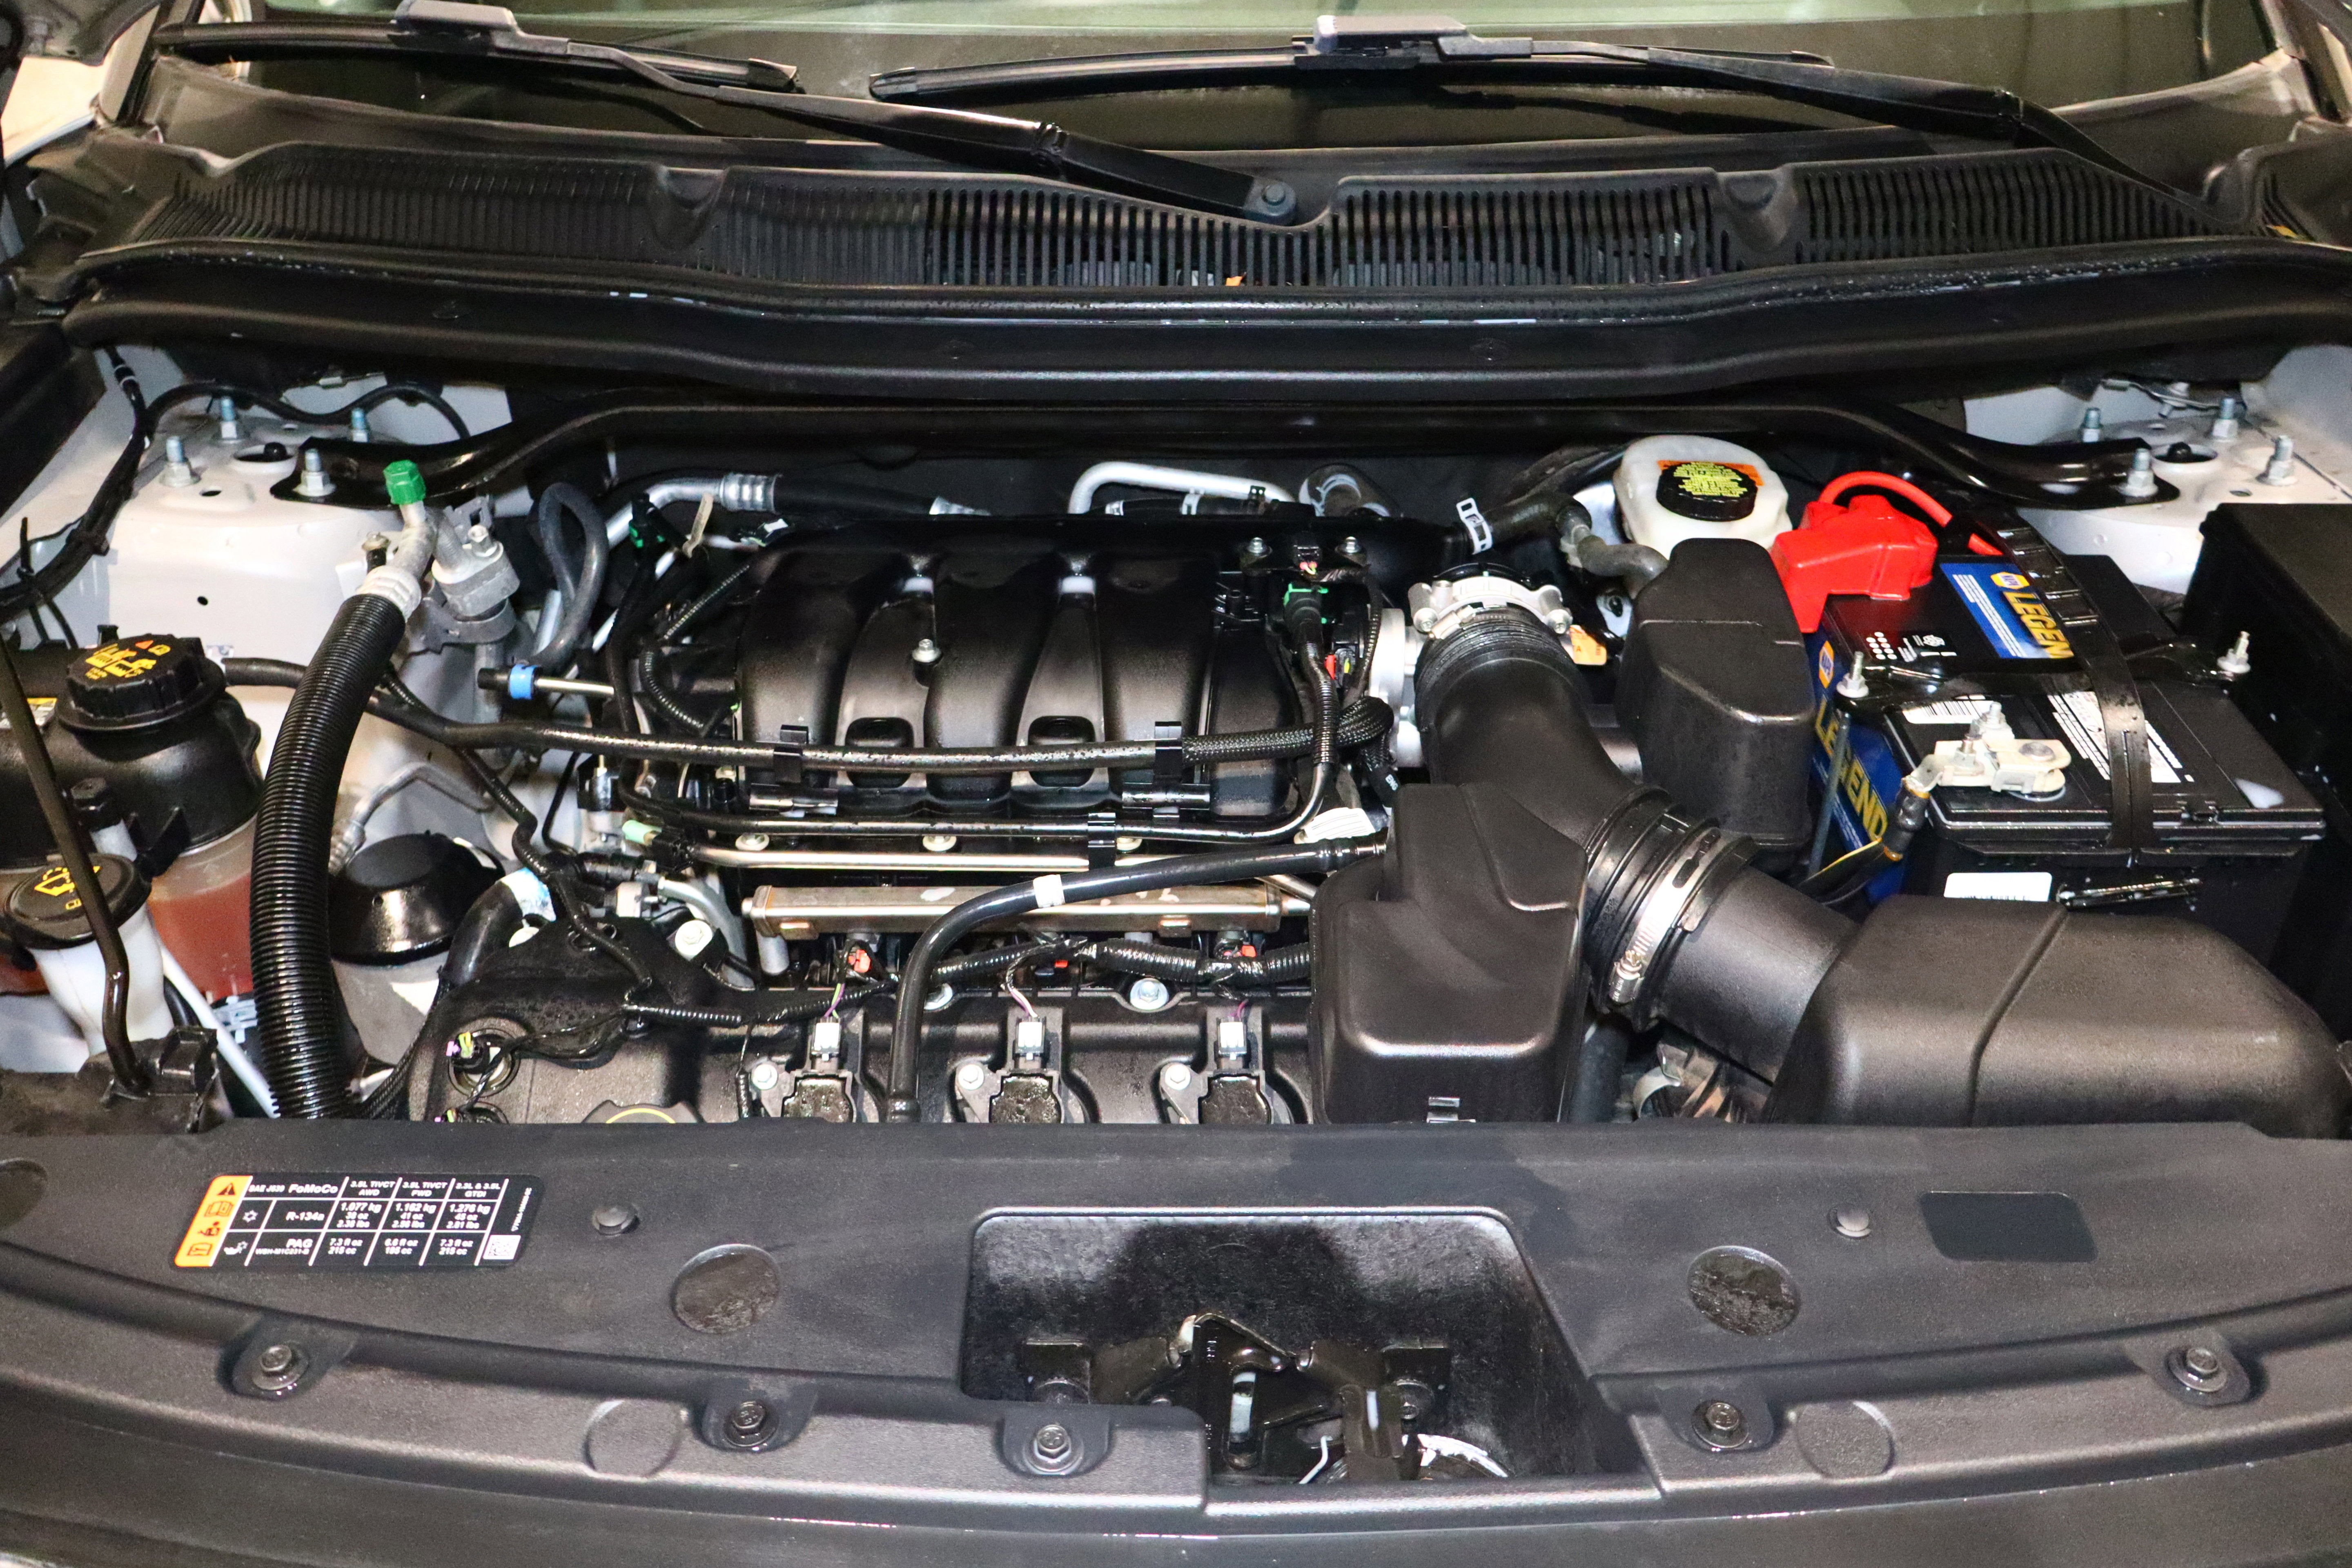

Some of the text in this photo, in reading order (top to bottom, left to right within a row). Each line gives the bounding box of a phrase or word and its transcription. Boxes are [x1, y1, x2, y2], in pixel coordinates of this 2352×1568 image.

[1815, 695, 1887, 841] LEEND
[288, 1184, 338, 1194] FoMoCo
[341, 1202, 382, 1214] 1.077 kg
[396, 1203, 437, 1214] 1.162 kg
[450, 1204, 491, 1215] 1.276 kg
[286, 1211, 325, 1221] R-134a
[454, 1213, 466, 1221] 45
[286, 1238, 313, 1248] PAG
[330, 1238, 343, 1246] 7.3
[440, 1239, 454, 1247] 7.3
[328, 1246, 345, 1254] 215
[439, 1247, 456, 1255] 215
